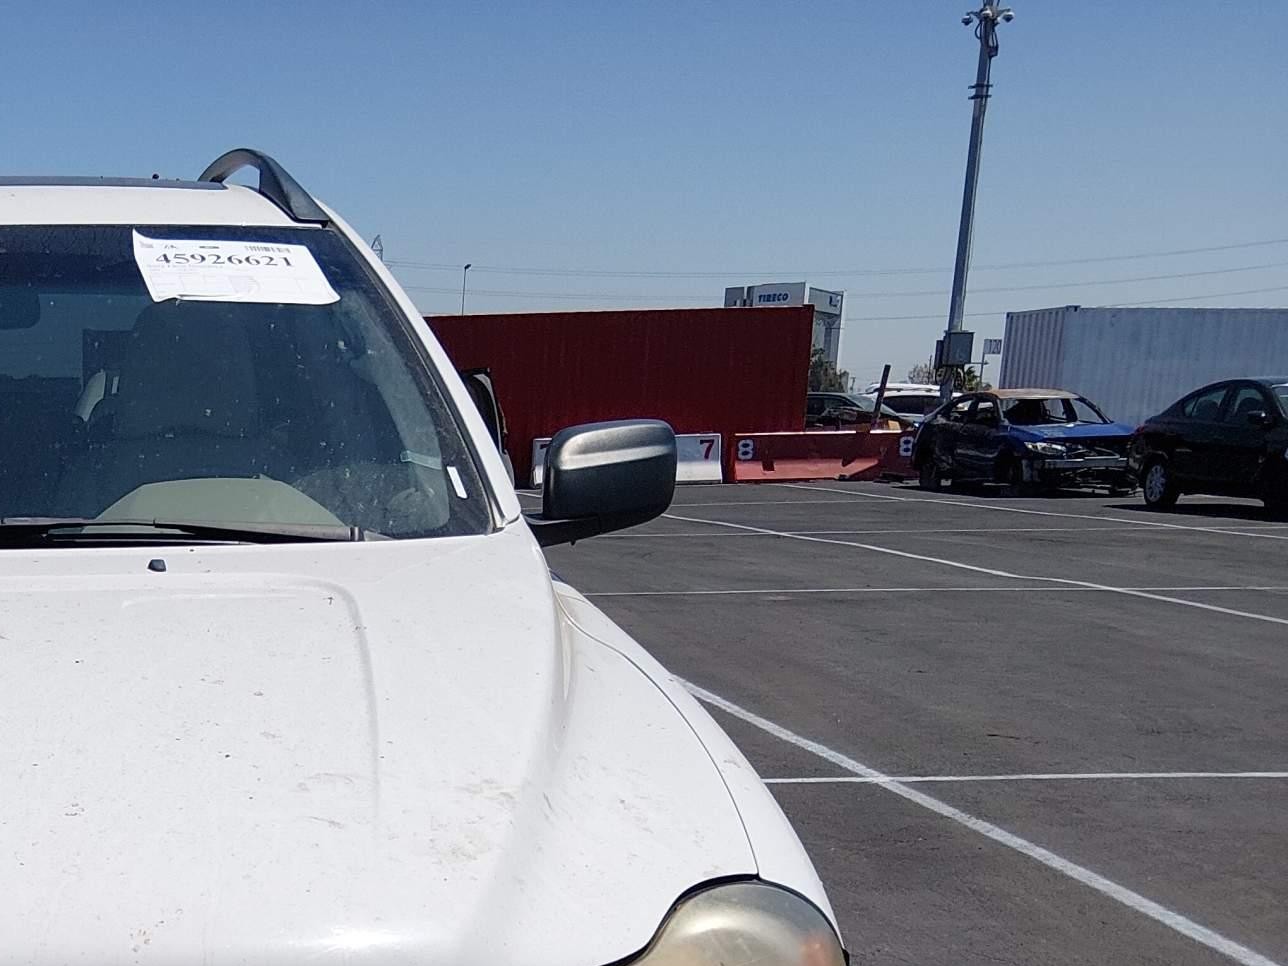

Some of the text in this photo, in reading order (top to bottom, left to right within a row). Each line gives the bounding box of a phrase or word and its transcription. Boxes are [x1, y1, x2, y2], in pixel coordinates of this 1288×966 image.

[156, 253, 293, 267] 45926621
[758, 293, 789, 303] TIRECO
[699, 439, 715, 460] 7
[738, 439, 754, 460] 8
[899, 436, 914, 457] 8
